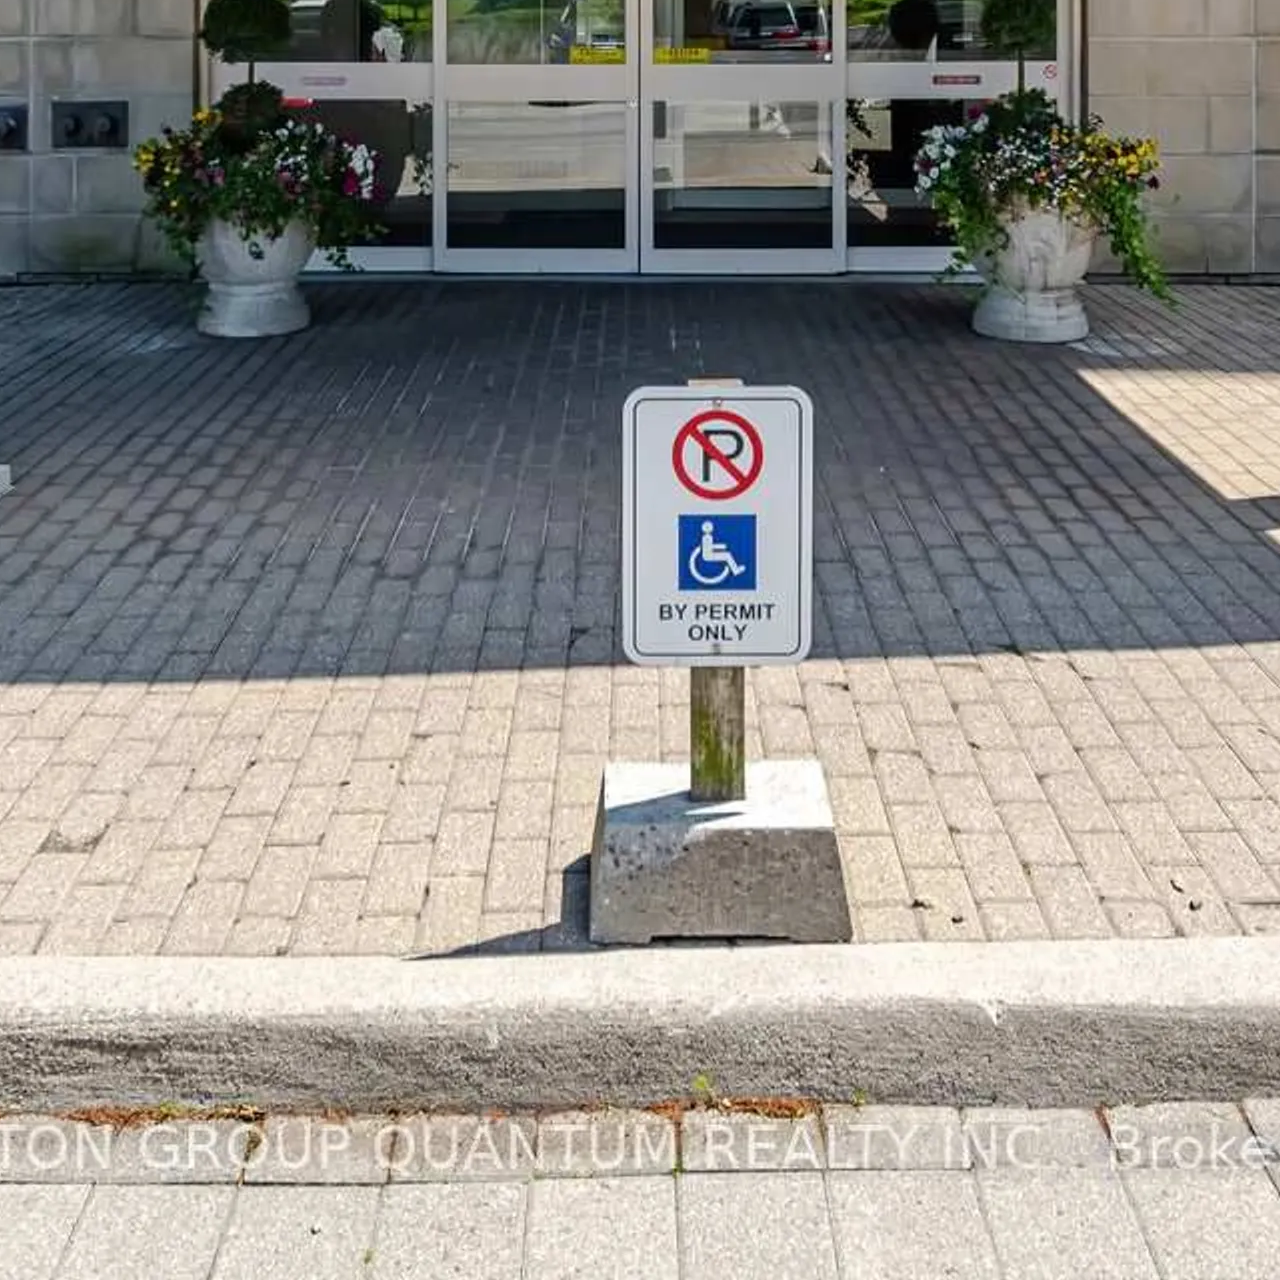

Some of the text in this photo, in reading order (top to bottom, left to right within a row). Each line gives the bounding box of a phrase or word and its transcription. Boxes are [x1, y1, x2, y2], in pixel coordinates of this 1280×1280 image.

[659, 603, 775, 621] BY PERMIT
[688, 624, 747, 641] ONLY
